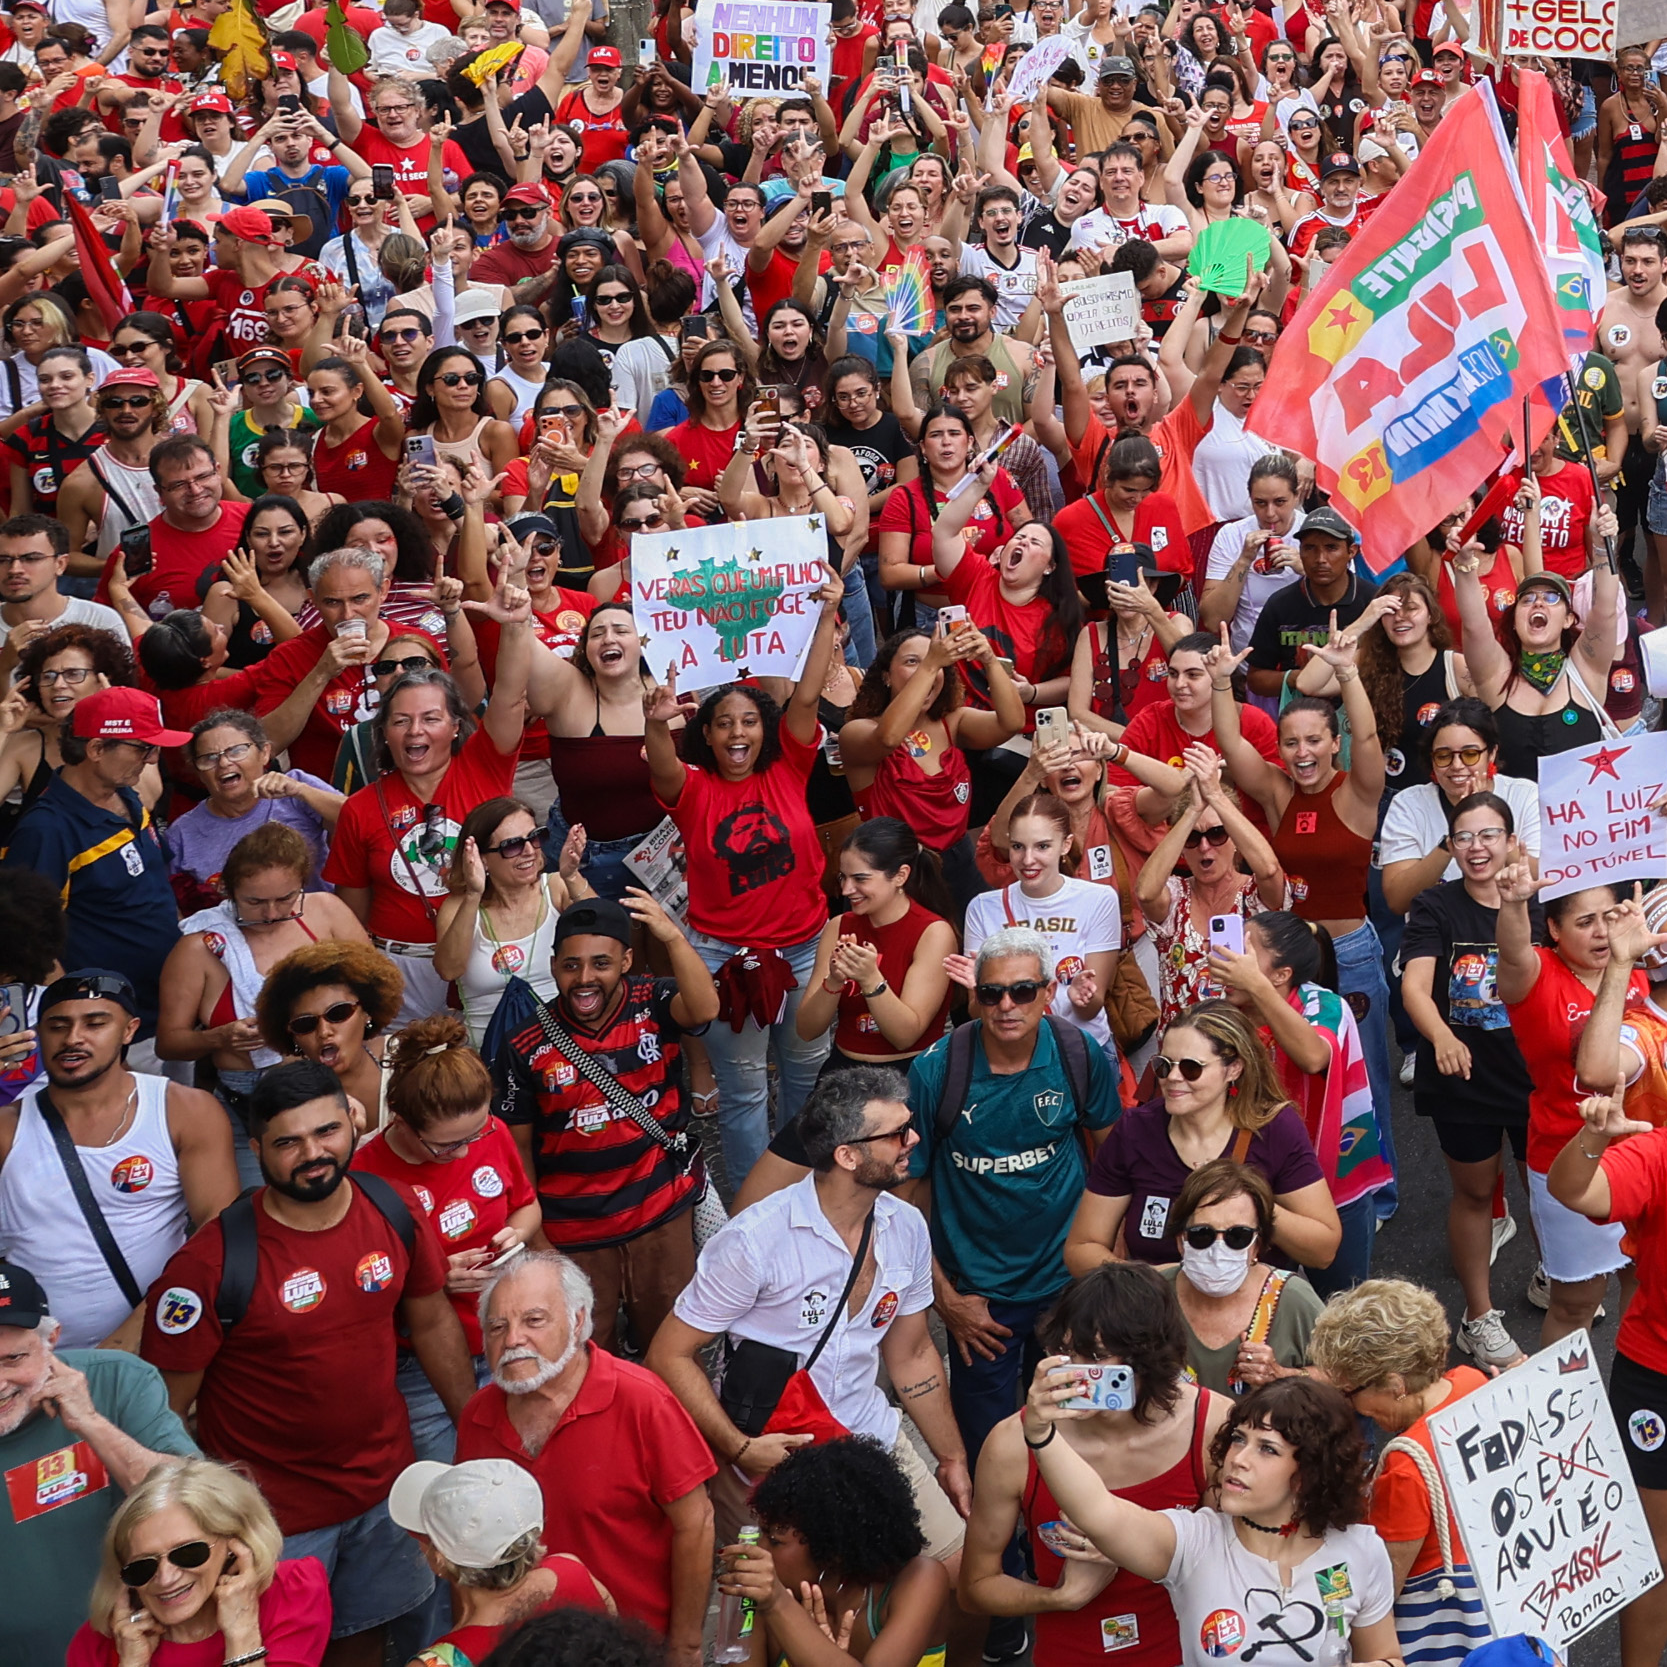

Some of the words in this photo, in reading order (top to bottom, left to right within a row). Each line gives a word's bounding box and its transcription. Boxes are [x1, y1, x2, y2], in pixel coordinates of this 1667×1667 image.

[712, 3, 818, 35] NENHUM
[713, 32, 816, 63] DIREITO
[1509, 29, 1528, 47] DE
[706, 60, 722, 87] A
[1101, 303, 1122, 315] SEUS
[1080, 315, 1134, 337] DIREITOS!
[637, 574, 710, 601] VERAS
[712, 570, 749, 594] QUE
[750, 566, 775, 588] UM
[777, 560, 824, 586] FILHO
[650, 611, 688, 632] TEU
[696, 599, 746, 628] NÃO
[752, 594, 806, 618] FOGE
[680, 638, 698, 669] À
[719, 631, 786, 662] LUTA
[105, 719, 124, 727] MST
[1592, 755, 1610, 767] 13
[1546, 788, 1587, 826] HÁ
[1563, 830, 1597, 852] NO
[1608, 814, 1652, 843] FIM
[1544, 863, 1582, 886] DO
[1585, 845, 1667, 874] TÚNEL
[1038, 1095, 1060, 1108] F.F.C.
[951, 1141, 1059, 1175] SUPERBET
[1456, 1387, 1585, 1484] FODA-SE
[1490, 1471, 1533, 1538] OS
[1537, 1434, 1604, 1503] EUA
[1496, 1511, 1573, 1591] AQUI
[1602, 1481, 1624, 1512] O
[1521, 1529, 1622, 1625] BRASIL
